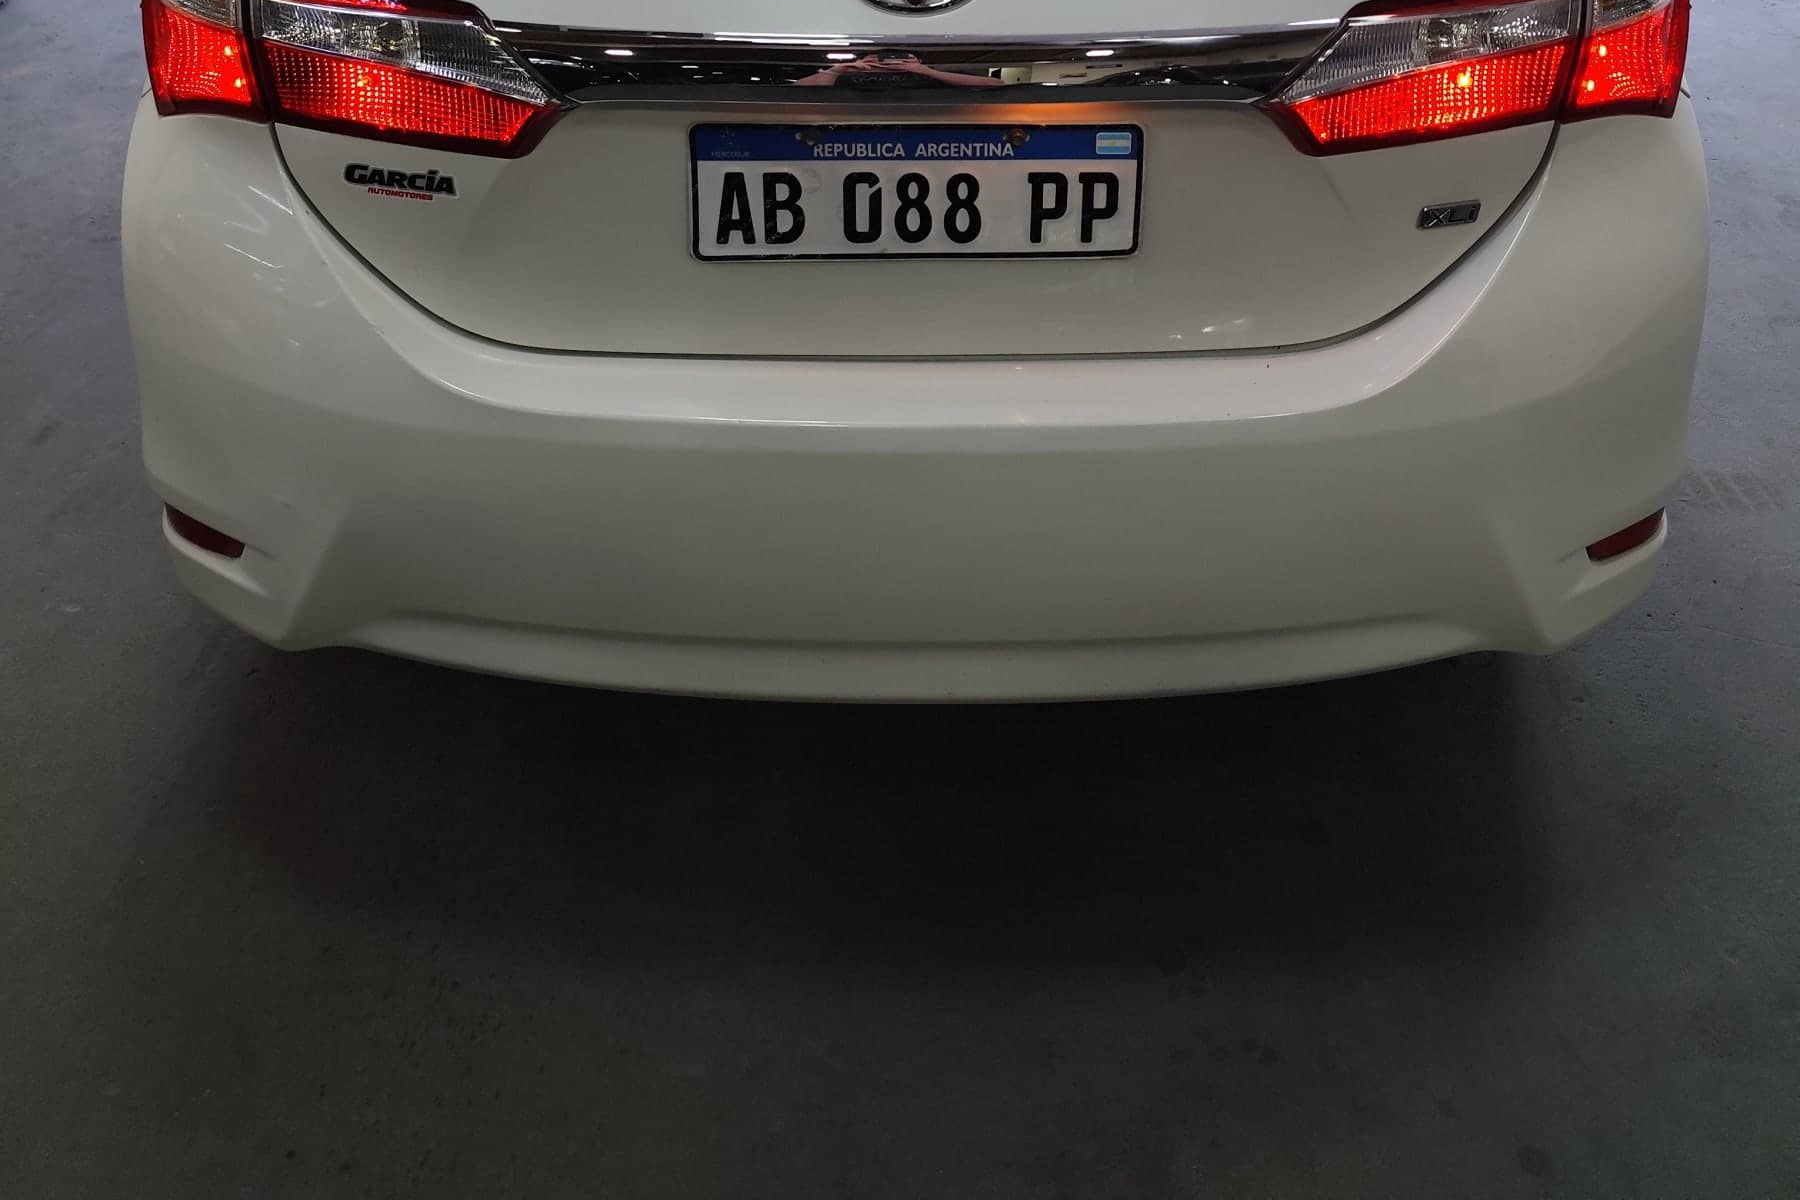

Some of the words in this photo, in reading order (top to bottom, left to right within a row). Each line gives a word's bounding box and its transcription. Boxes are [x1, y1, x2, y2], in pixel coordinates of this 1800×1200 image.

[813, 143, 906, 158] REPUBLICA
[914, 143, 1015, 158] ARGENTINA
[344, 163, 456, 195] GARCÍA
[367, 186, 434, 201] AUTOMOTORES
[716, 171, 806, 245] AB
[842, 172, 982, 244] 088
[1027, 171, 1119, 244] PP
